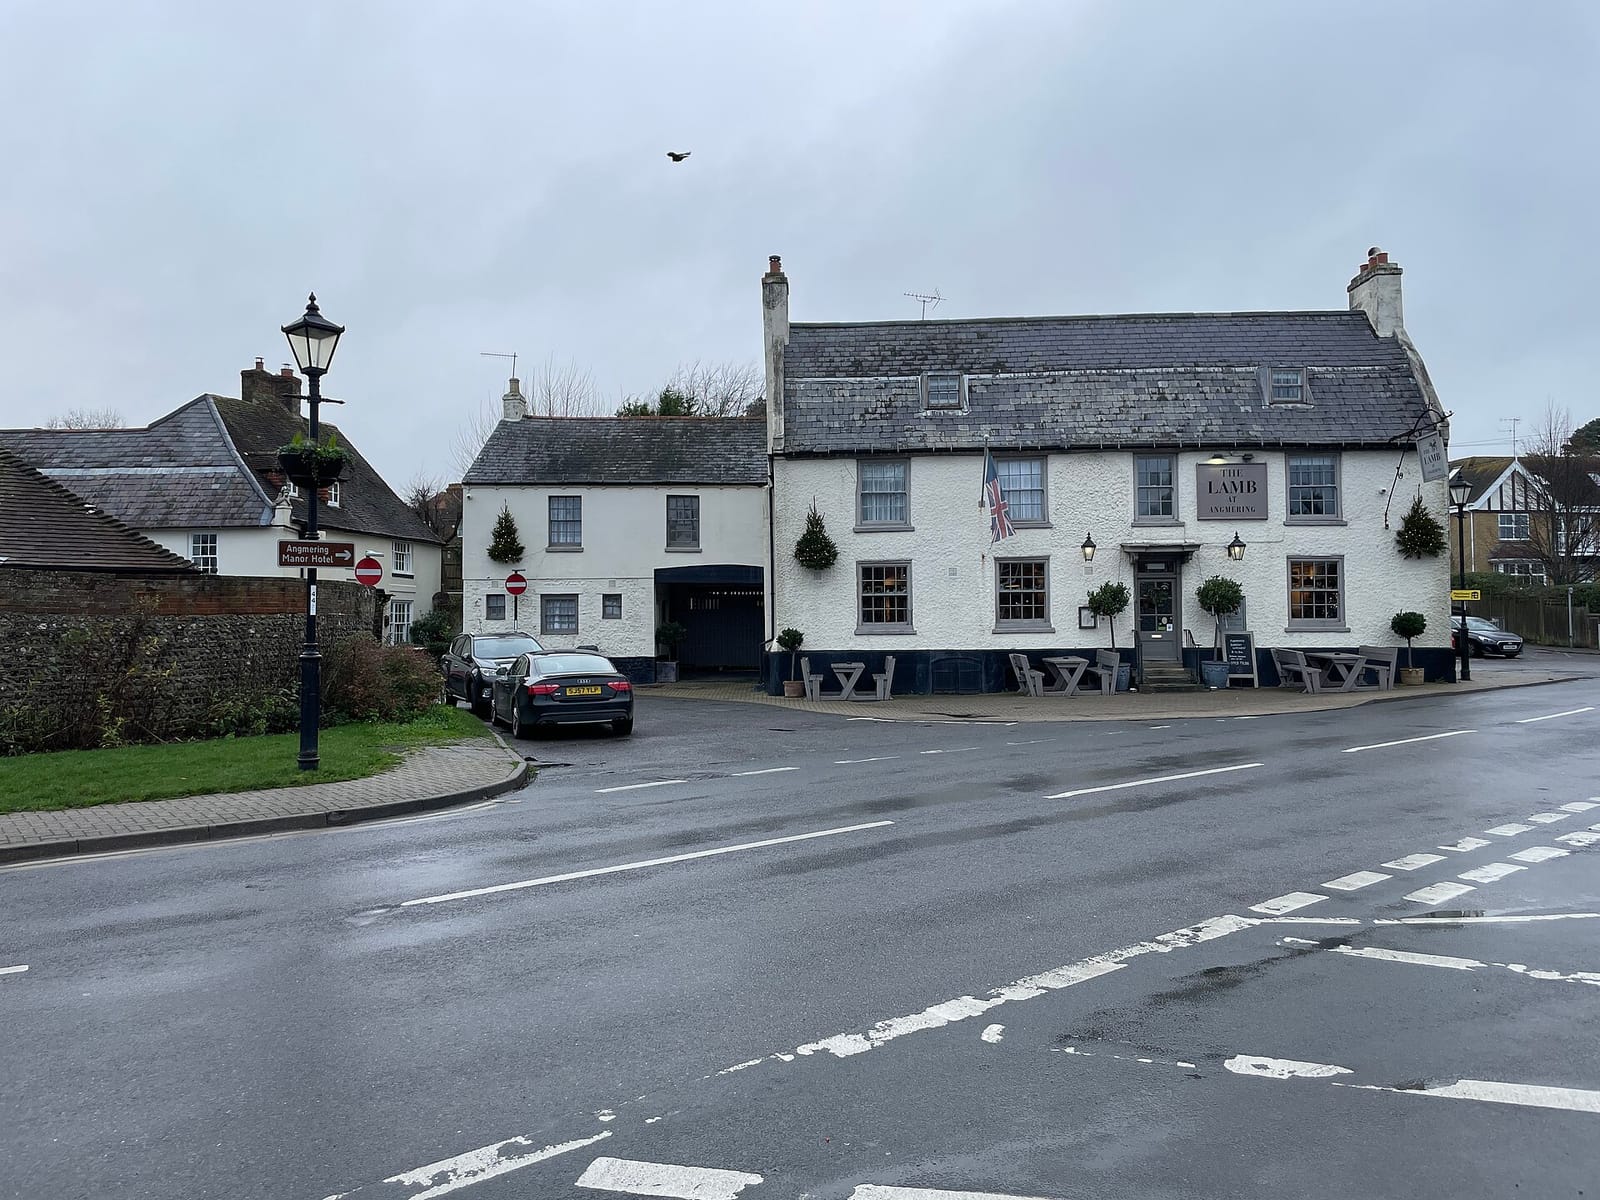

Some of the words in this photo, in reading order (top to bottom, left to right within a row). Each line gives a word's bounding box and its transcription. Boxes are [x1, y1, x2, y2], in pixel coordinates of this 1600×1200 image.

[1221, 468, 1243, 477] THE
[1208, 480, 1257, 494] LAMB
[286, 544, 329, 555] Angmering
[282, 554, 308, 563] Manor
[311, 554, 334, 564] Hotel
